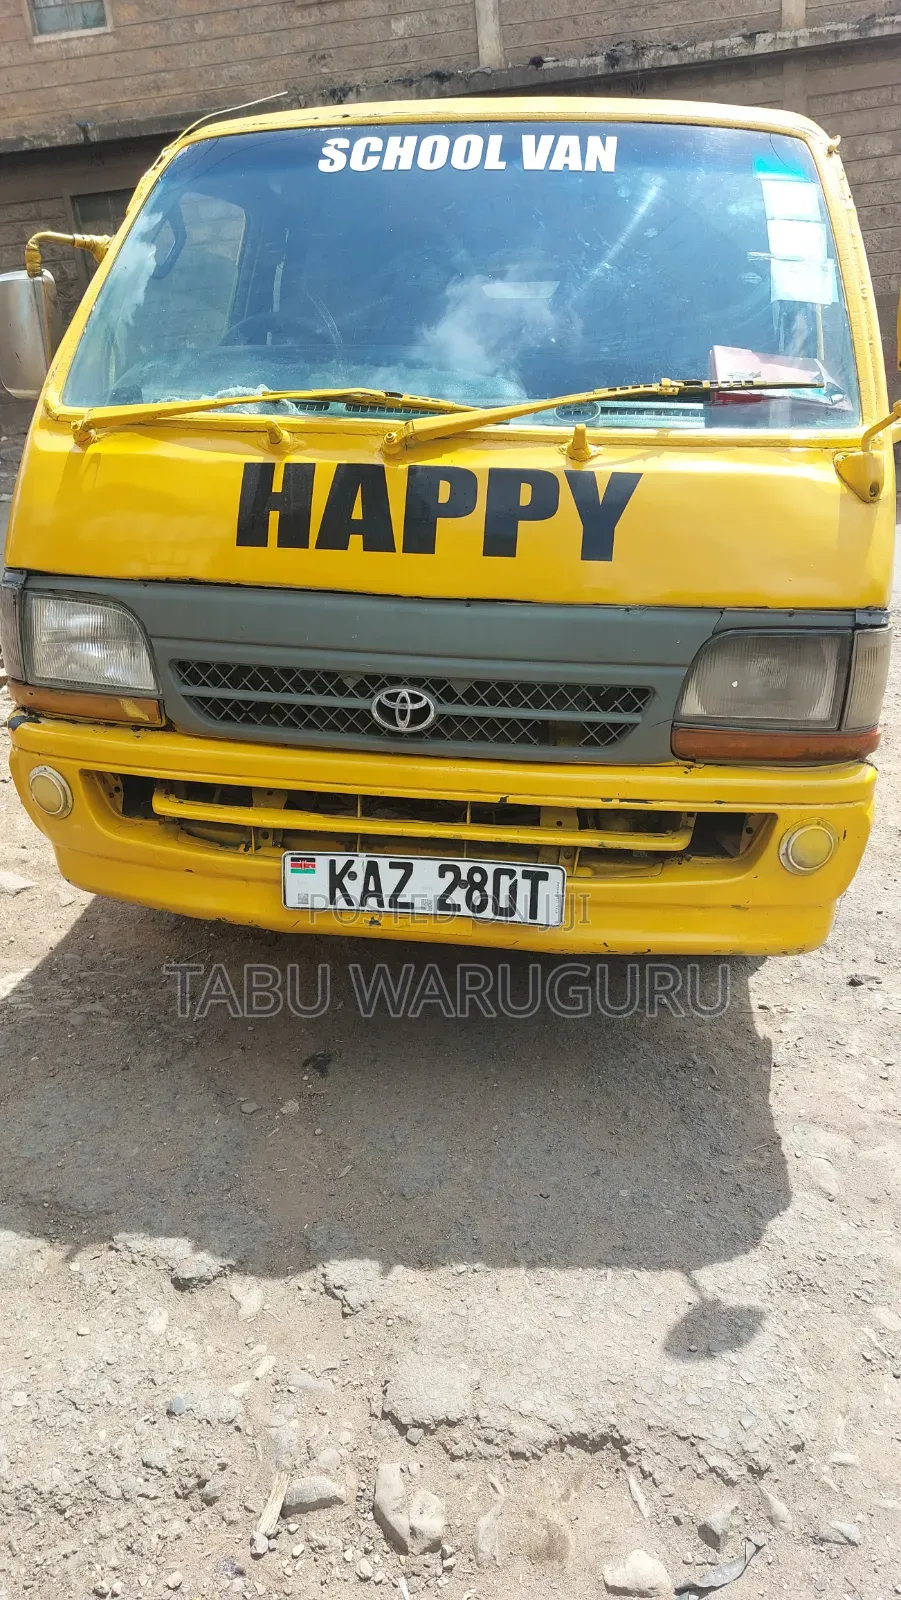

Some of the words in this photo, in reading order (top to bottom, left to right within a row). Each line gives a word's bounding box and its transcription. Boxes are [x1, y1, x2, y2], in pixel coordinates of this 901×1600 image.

[317, 134, 506, 173] SCHOOL
[521, 134, 618, 173] VAN
[236, 462, 643, 562] HAPPY
[328, 858, 414, 910] KAZ
[436, 863, 549, 920] 280T
